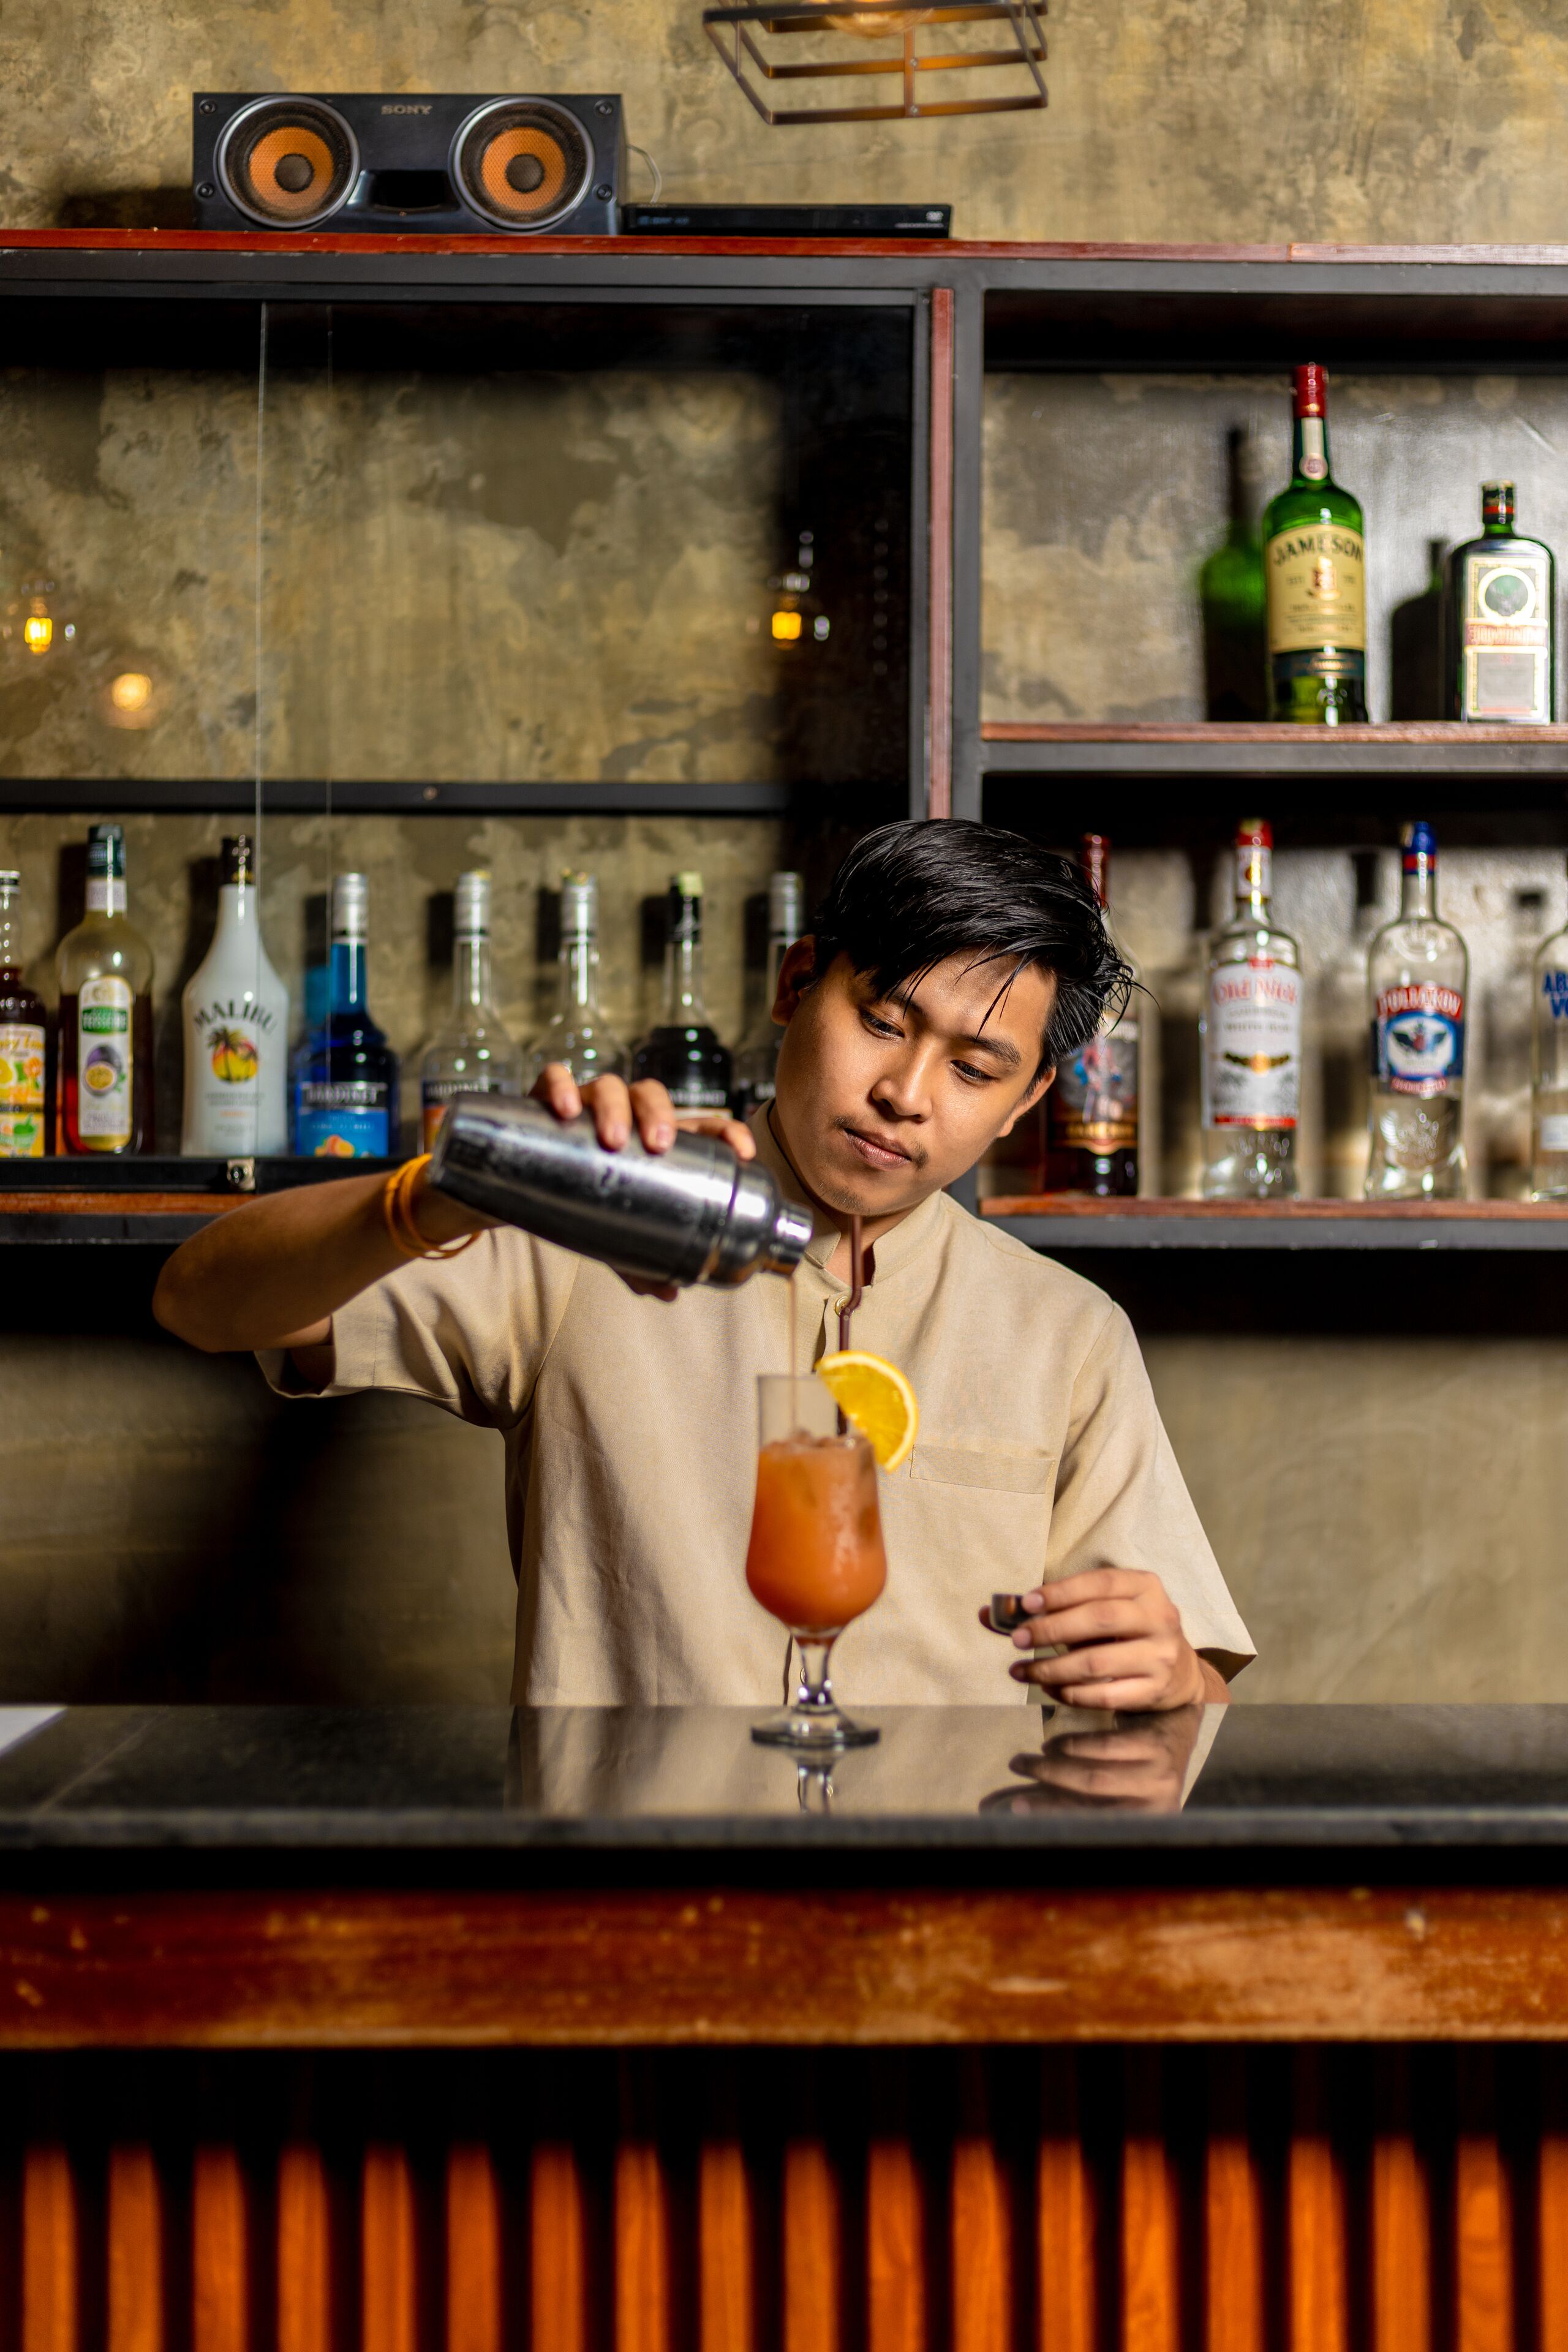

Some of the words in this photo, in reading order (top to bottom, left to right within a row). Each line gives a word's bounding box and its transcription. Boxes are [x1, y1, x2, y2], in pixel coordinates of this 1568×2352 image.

[381, 104, 434, 116] SONY
[1273, 532, 1363, 567] JAMESON
[194, 998, 278, 1036] MALIBU
